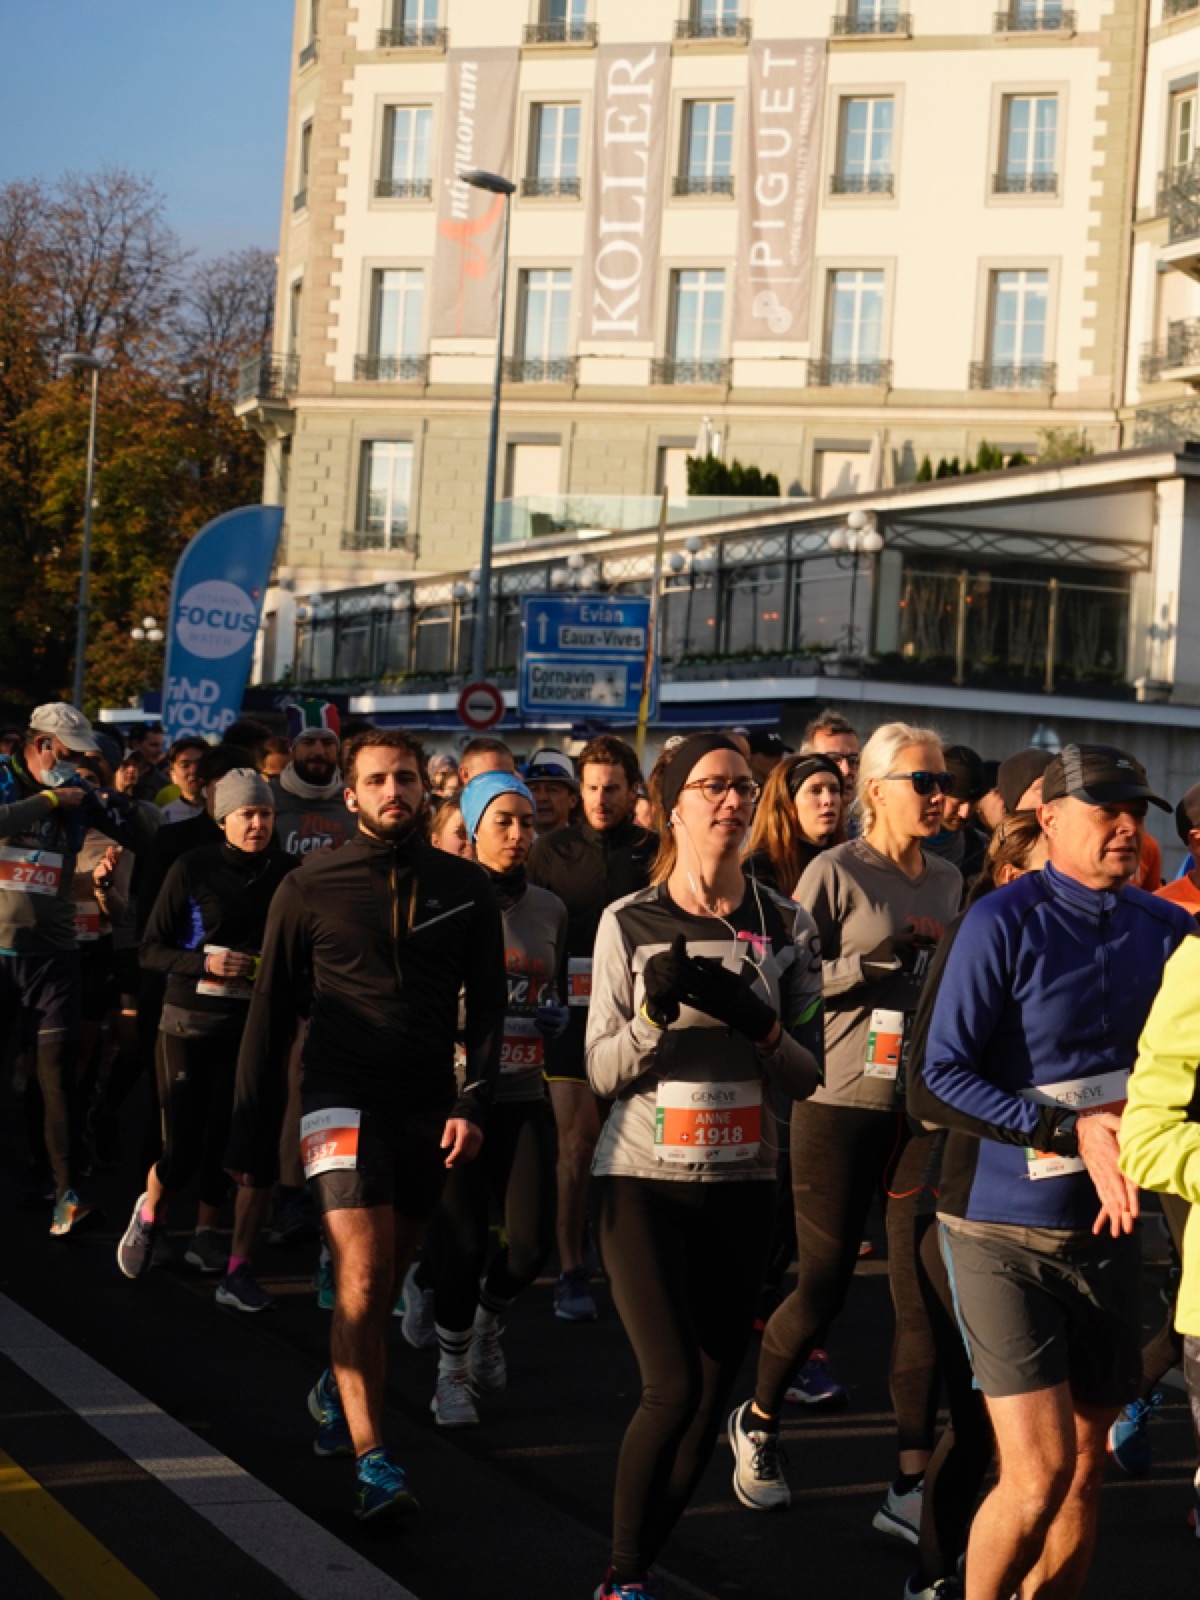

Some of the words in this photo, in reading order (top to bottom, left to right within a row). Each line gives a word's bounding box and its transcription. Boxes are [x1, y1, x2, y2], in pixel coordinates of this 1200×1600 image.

[750, 48, 797, 268] PIGUET
[592, 47, 657, 337] KOLLER
[176, 605, 258, 633] FOCUS
[580, 605, 625, 623] Evian
[561, 629, 642, 647] Eaux-Vives
[531, 666, 595, 683] Cornavin
[12, 866, 57, 886] 2740
[691, 1090, 736, 1103] GENÈVE
[1056, 1085, 1104, 1105] GENÈVE
[695, 1111, 731, 1125] ANNE
[693, 1126, 744, 1146] 1918
